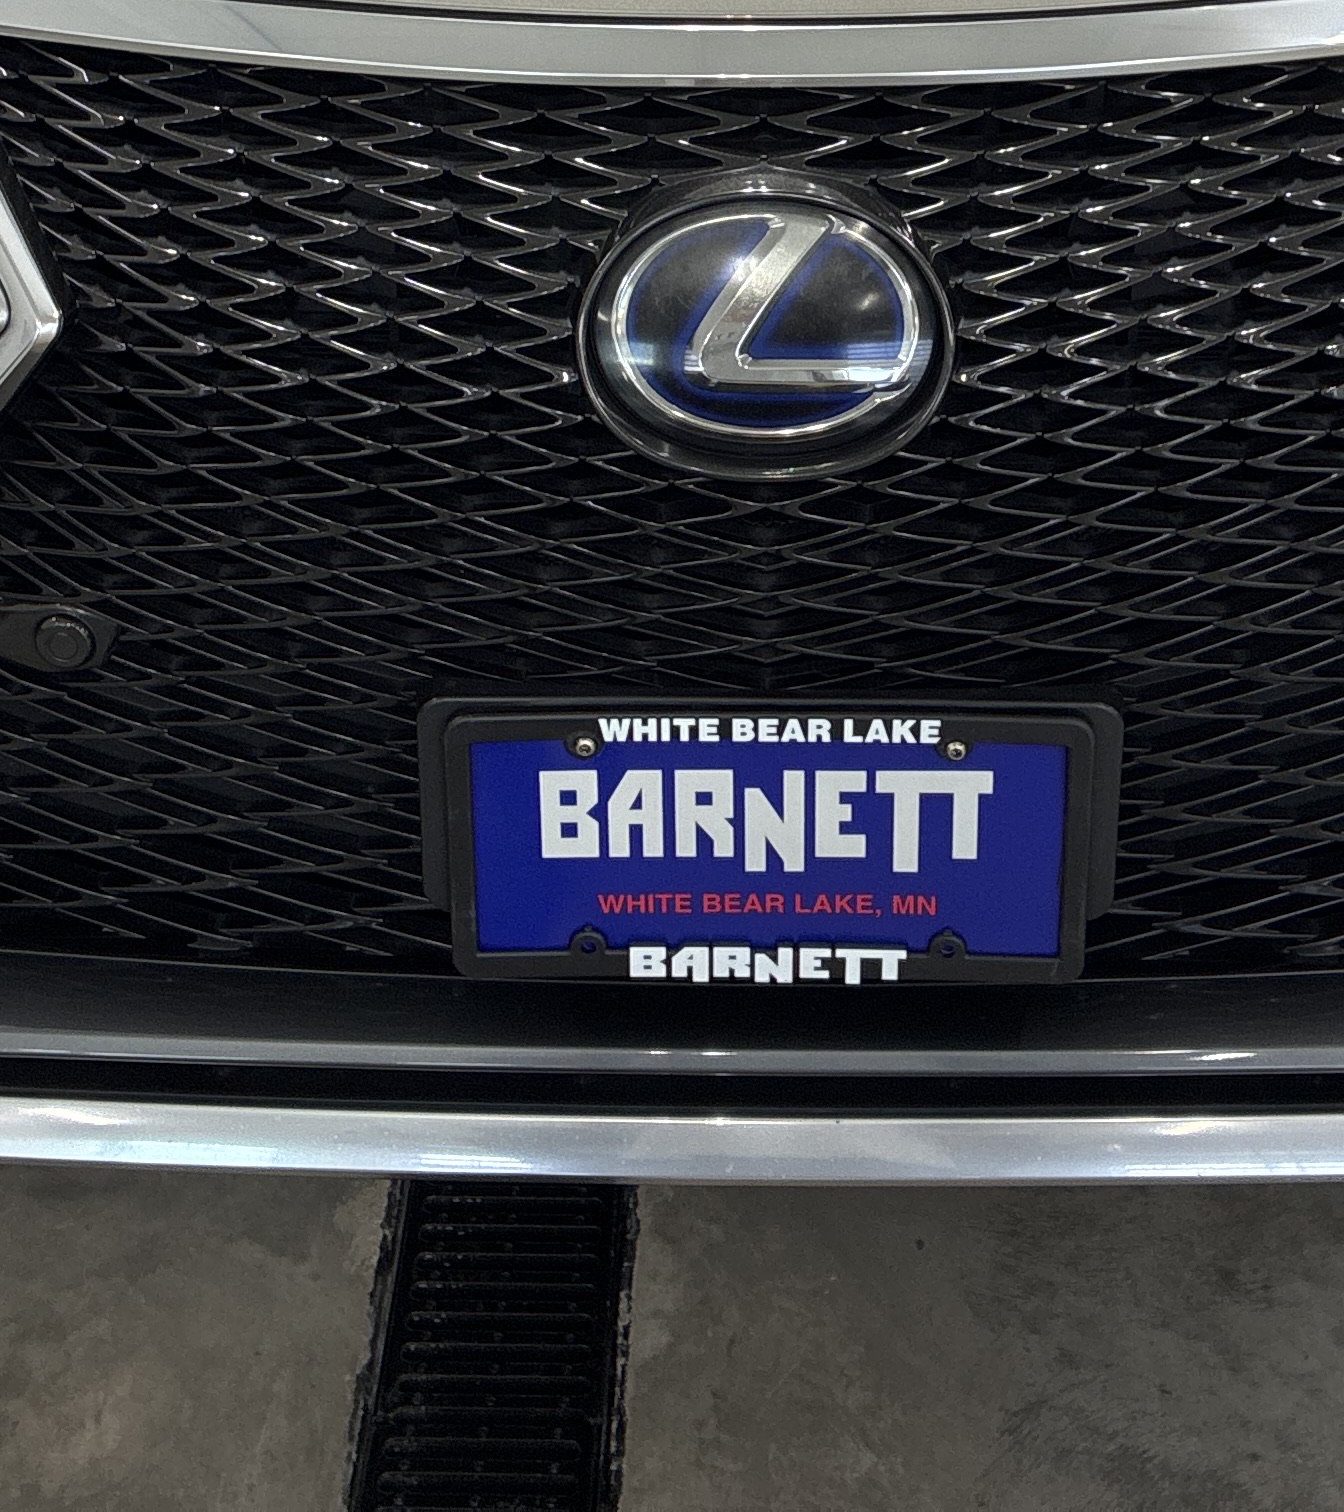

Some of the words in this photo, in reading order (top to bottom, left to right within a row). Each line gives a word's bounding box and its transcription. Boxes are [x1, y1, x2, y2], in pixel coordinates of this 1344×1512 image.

[598, 717, 719, 743] WHITE
[732, 717, 831, 743] BEAR
[843, 719, 942, 744] LAKE
[539, 770, 994, 873] BARNETT
[598, 892, 691, 915] WHITE
[702, 892, 785, 915] BEAR
[794, 893, 883, 917] LAKE,
[891, 894, 938, 916] MN
[629, 946, 908, 985] BARNETT
